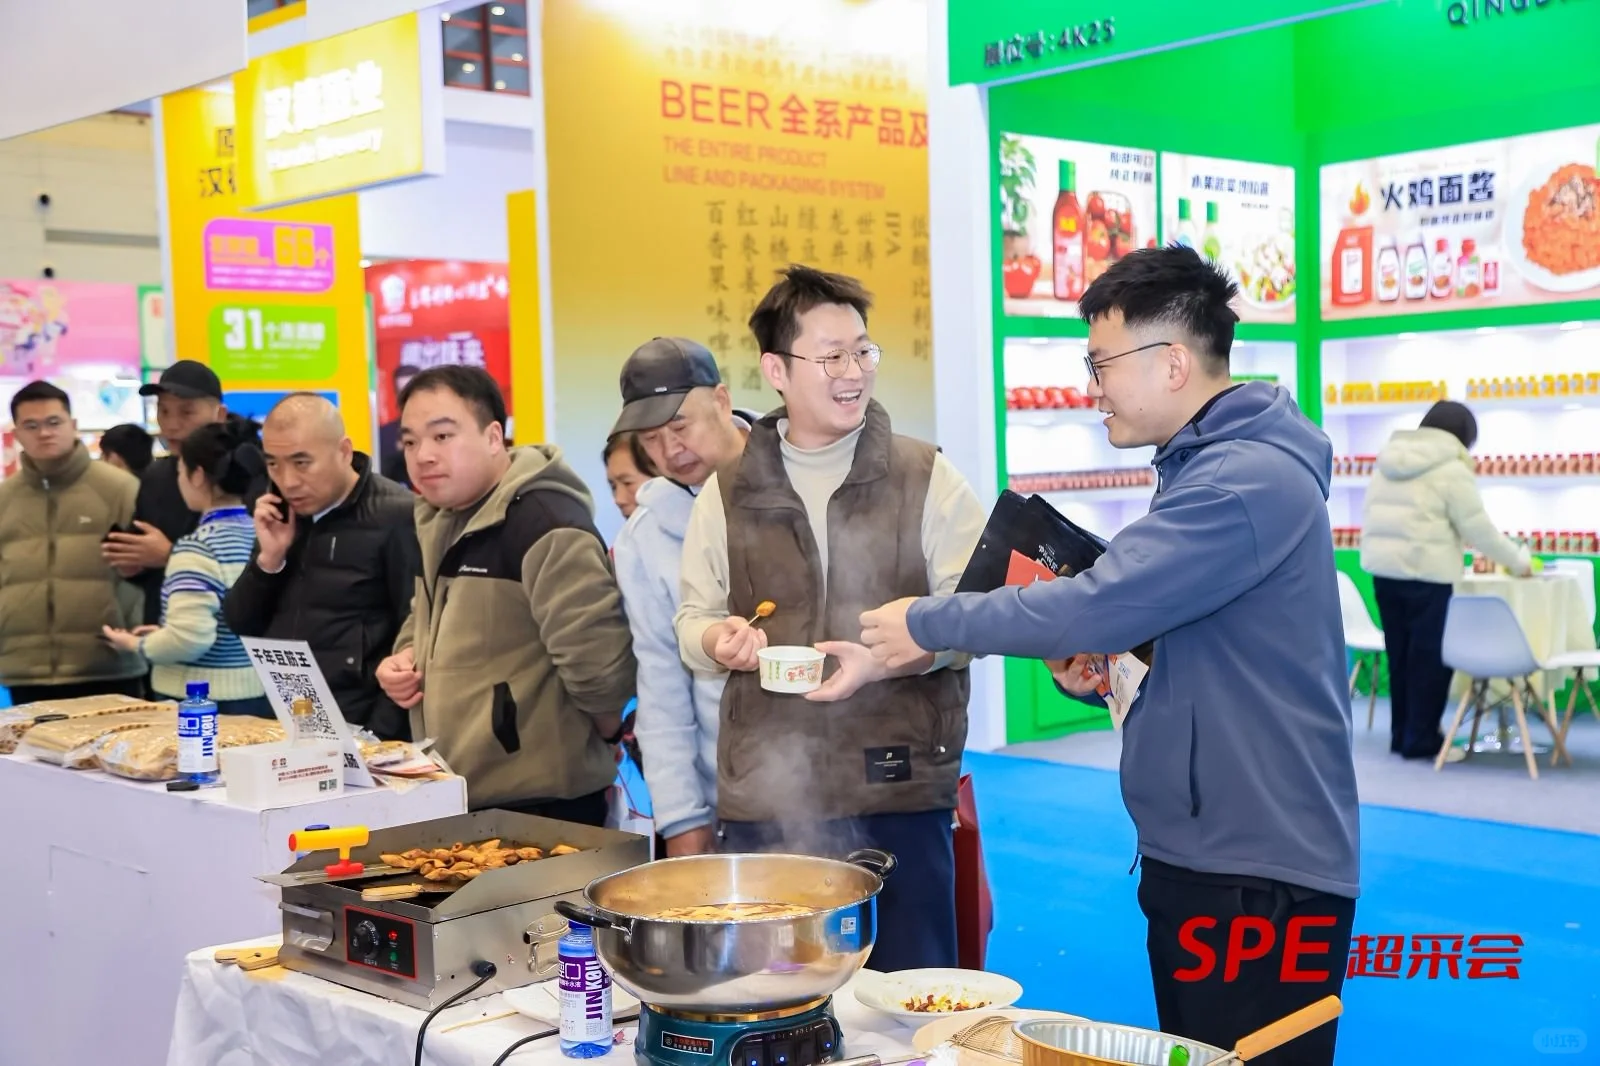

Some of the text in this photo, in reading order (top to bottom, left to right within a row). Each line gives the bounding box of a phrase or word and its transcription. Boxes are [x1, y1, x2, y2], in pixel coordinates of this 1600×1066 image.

[661, 80, 772, 130] BEER
[663, 136, 827, 168] THE ENTIRE PRODUCT
[663, 166, 886, 201] LINE AND PACKAGING SYSTEM
[1380, 169, 1496, 212] 火鸡面酱
[252, 648, 311, 668] 千年豆筋王
